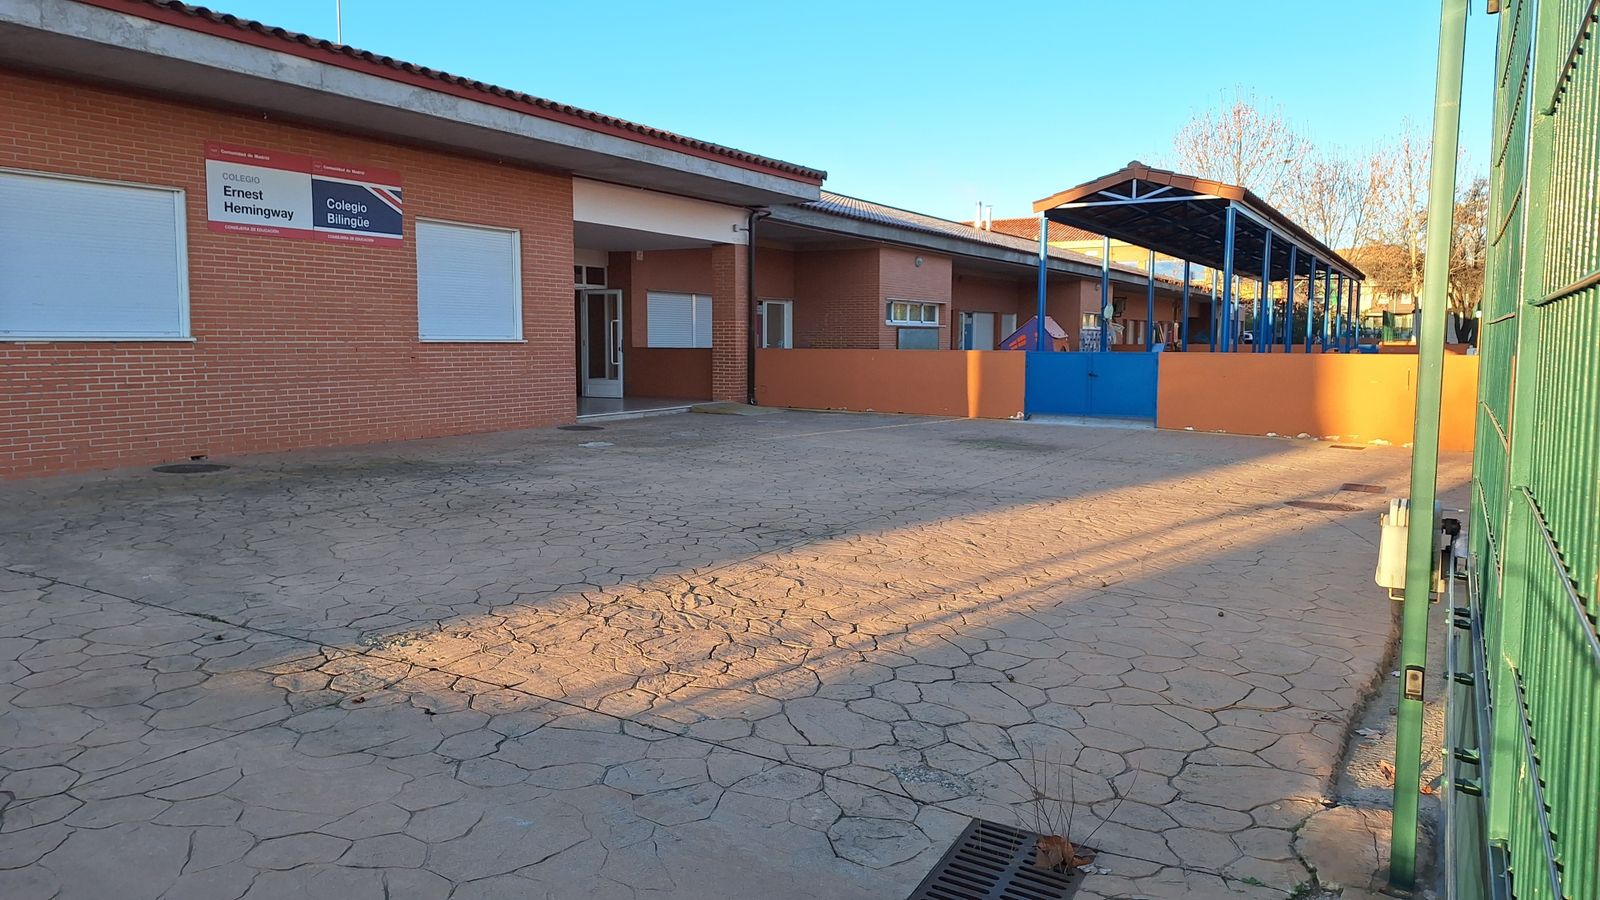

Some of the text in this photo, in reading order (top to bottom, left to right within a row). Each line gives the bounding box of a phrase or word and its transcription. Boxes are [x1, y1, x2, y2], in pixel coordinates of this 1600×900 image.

[222, 172, 260, 184] COLEGIO
[223, 185, 264, 200] Ernest
[224, 201, 294, 221] Hemingway
[326, 198, 367, 214] Colegio
[327, 212, 370, 228] Bilingüe
